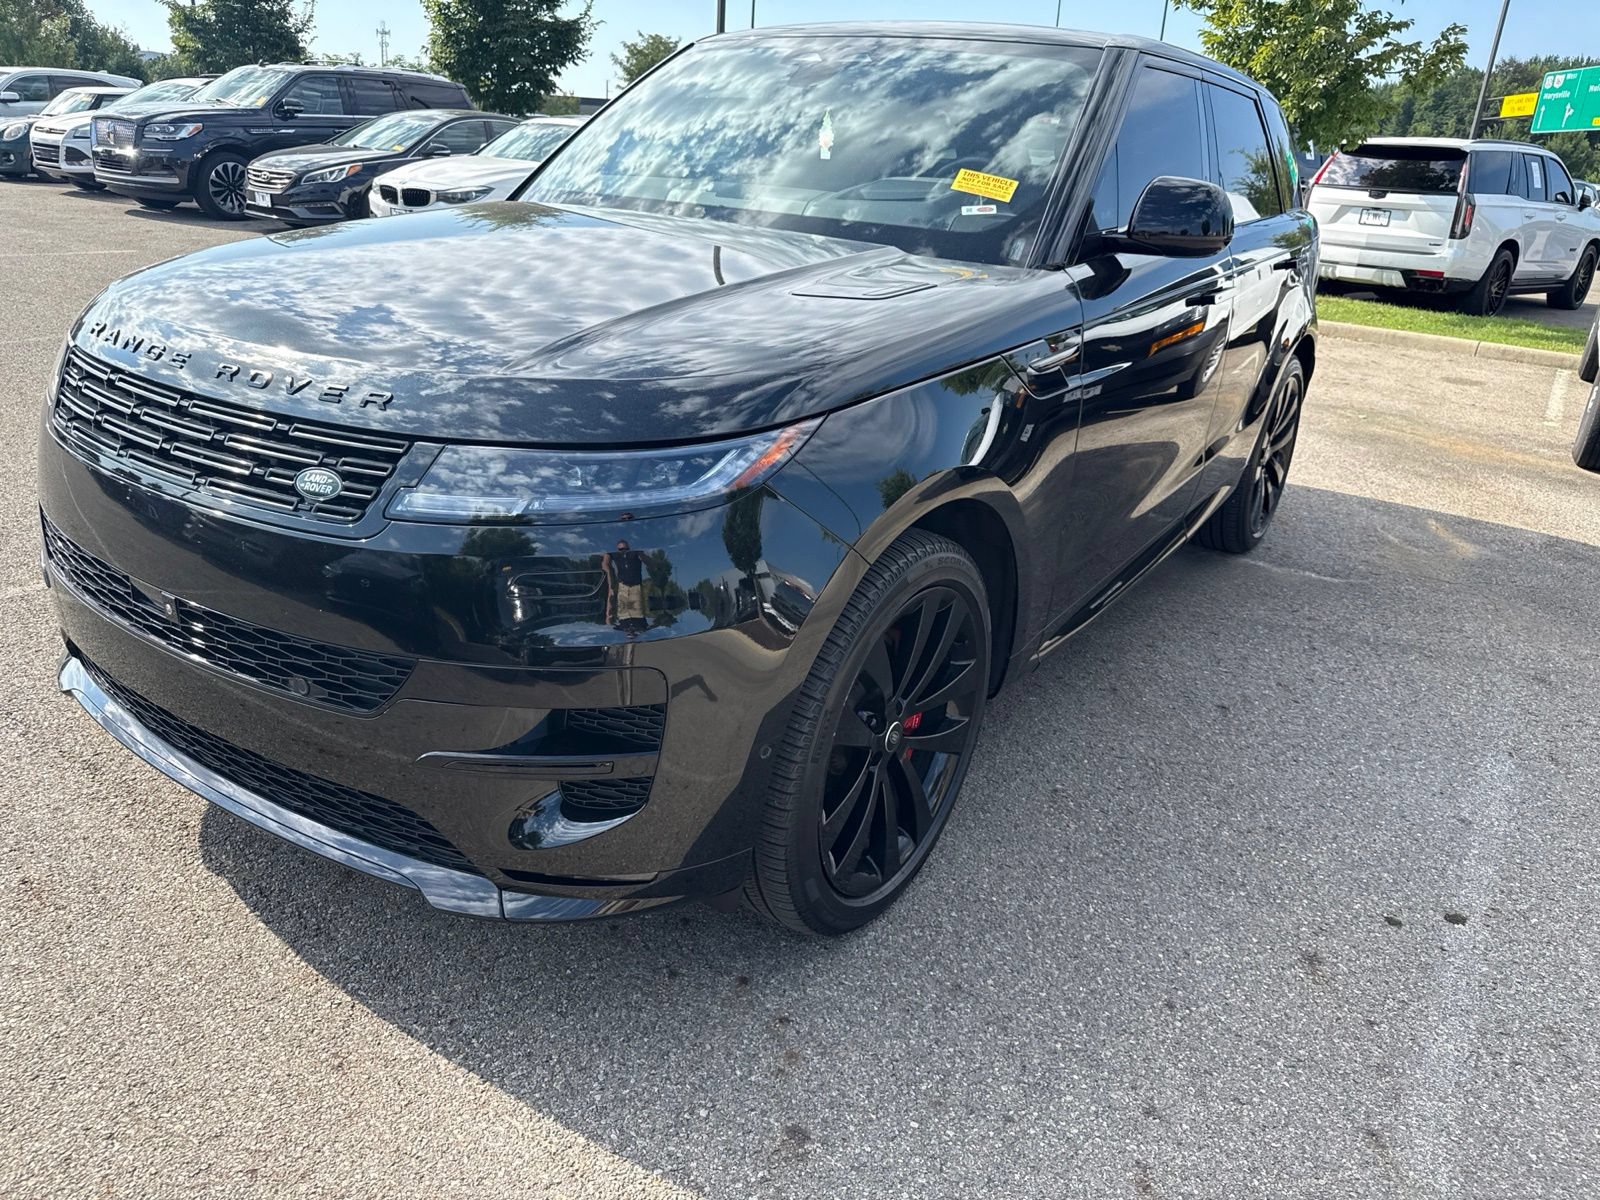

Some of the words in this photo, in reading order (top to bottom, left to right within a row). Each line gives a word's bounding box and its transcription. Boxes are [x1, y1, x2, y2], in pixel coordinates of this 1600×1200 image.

[1543, 90, 1571, 101] Marysville
[963, 171, 980, 179] THIS
[982, 175, 1015, 188] VEHICLE
[976, 179, 991, 187] FOR
[993, 183, 1010, 191] SALE
[89, 322, 192, 370] RANGE
[214, 363, 394, 411] ROVER
[304, 472, 328, 484] LAND
[303, 482, 333, 494] ROVER
